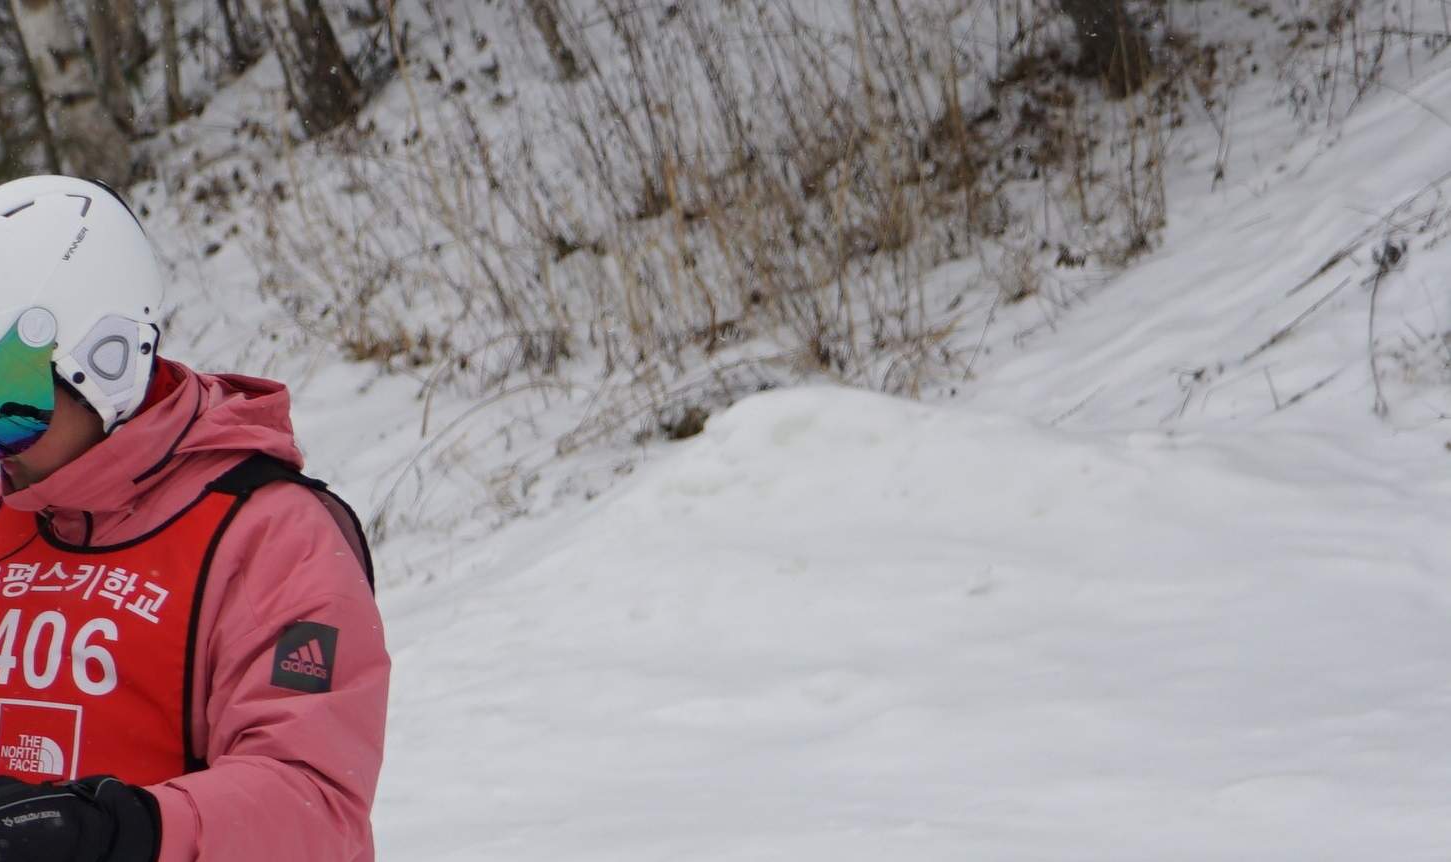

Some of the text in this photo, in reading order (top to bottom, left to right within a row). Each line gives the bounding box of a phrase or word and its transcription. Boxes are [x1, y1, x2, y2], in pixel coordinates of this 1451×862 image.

[280, 659, 327, 680] adidas
[18, 734, 43, 748] THE
[0, 745, 40, 761] NORTH
[8, 758, 39, 773] FACE
